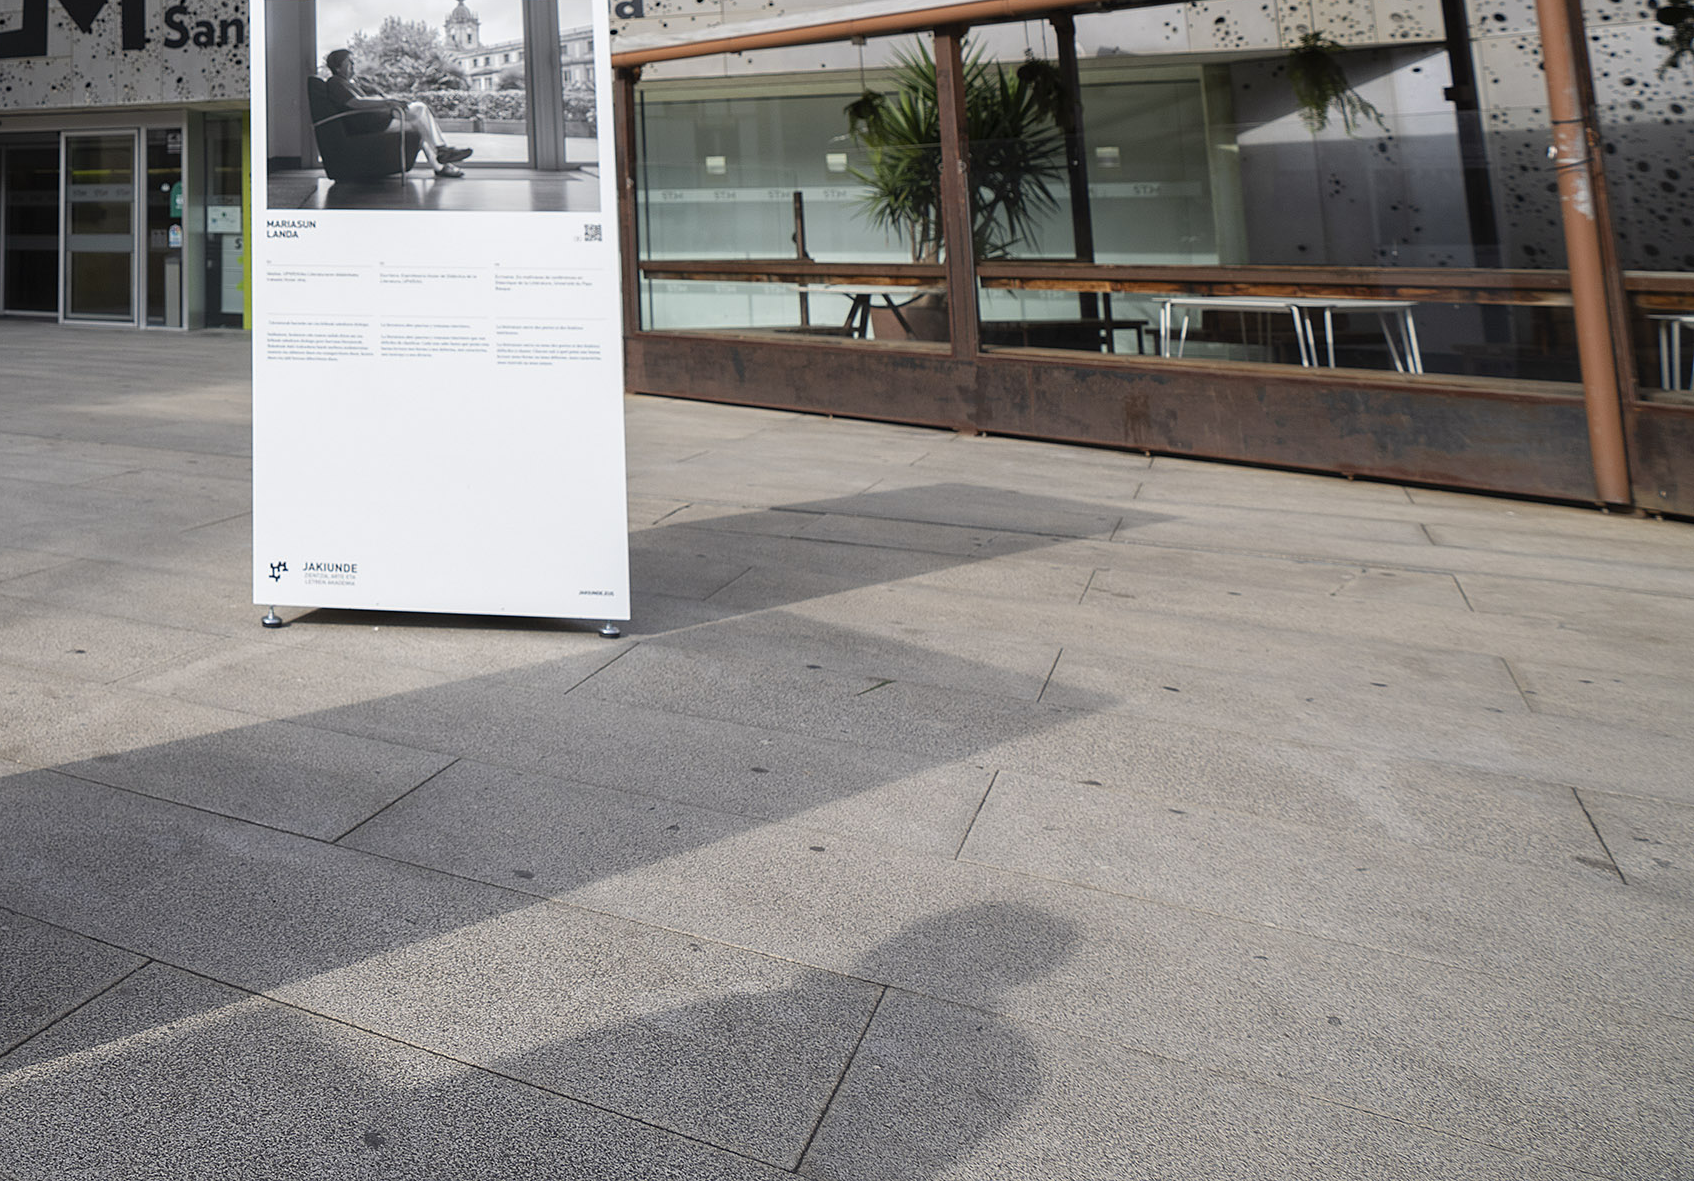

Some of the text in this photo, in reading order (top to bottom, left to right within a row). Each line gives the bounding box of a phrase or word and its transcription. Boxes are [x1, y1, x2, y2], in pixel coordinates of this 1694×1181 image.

[266, 220, 316, 229] MARIASUN
[266, 230, 299, 239] LANDA
[303, 562, 358, 573] JAKIUNDE
